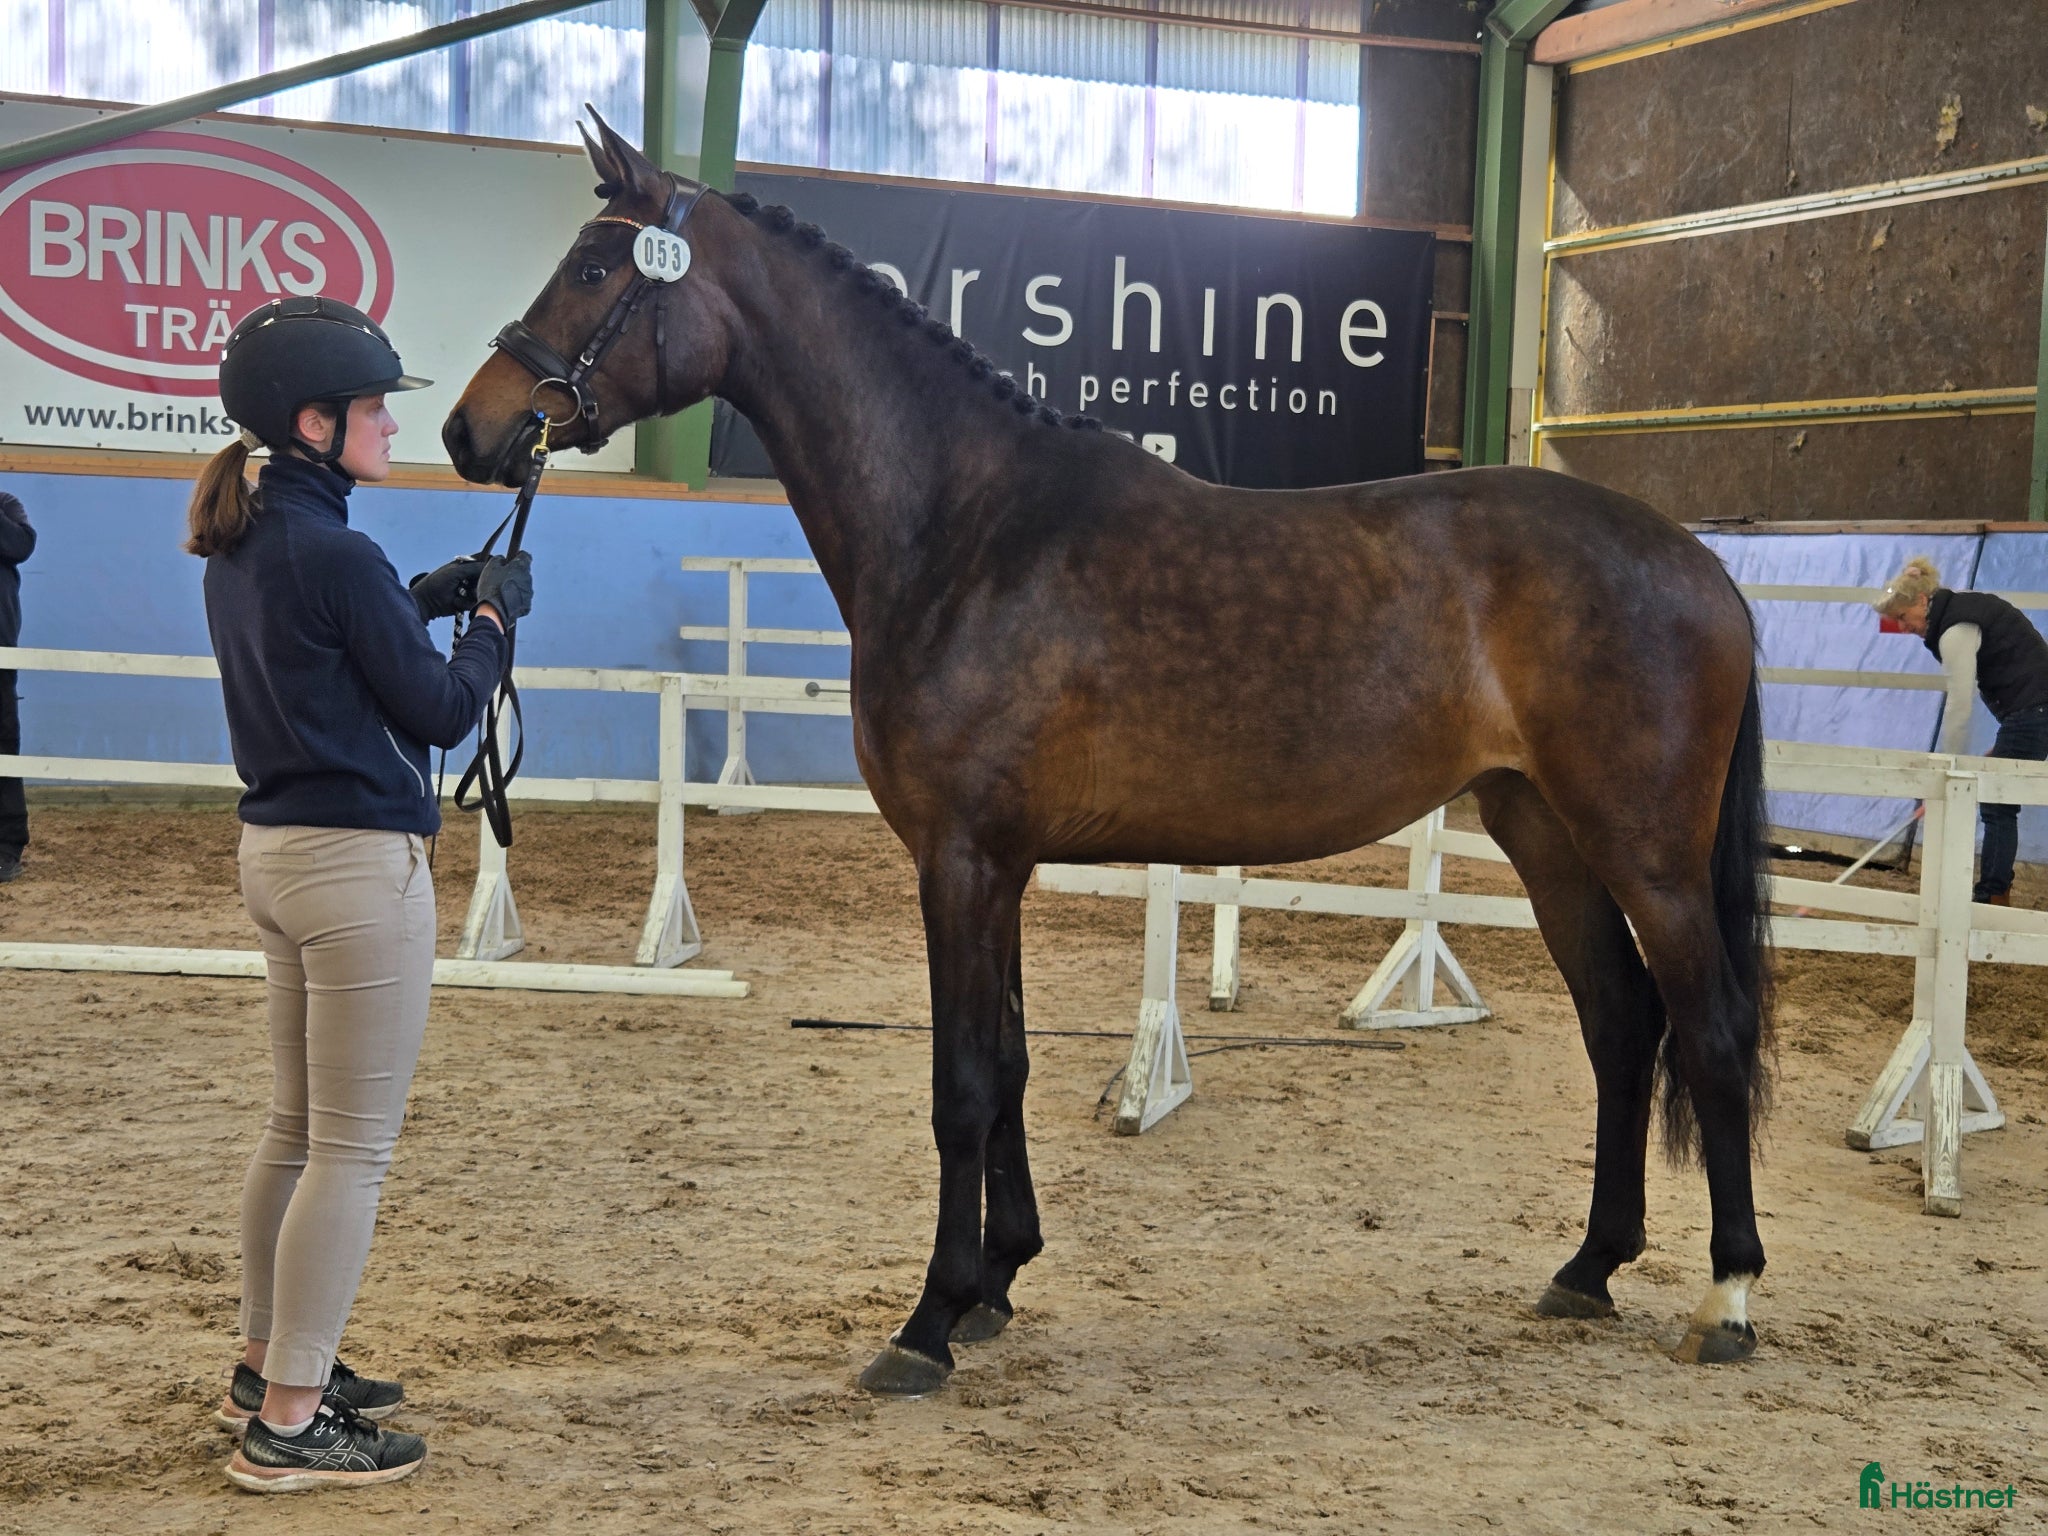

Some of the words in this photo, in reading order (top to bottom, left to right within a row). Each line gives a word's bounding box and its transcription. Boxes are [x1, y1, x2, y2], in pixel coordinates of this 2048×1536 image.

[29, 199, 327, 296] BRINKS
[644, 236, 681, 272] 053
[1079, 370, 1337, 416] perfection
